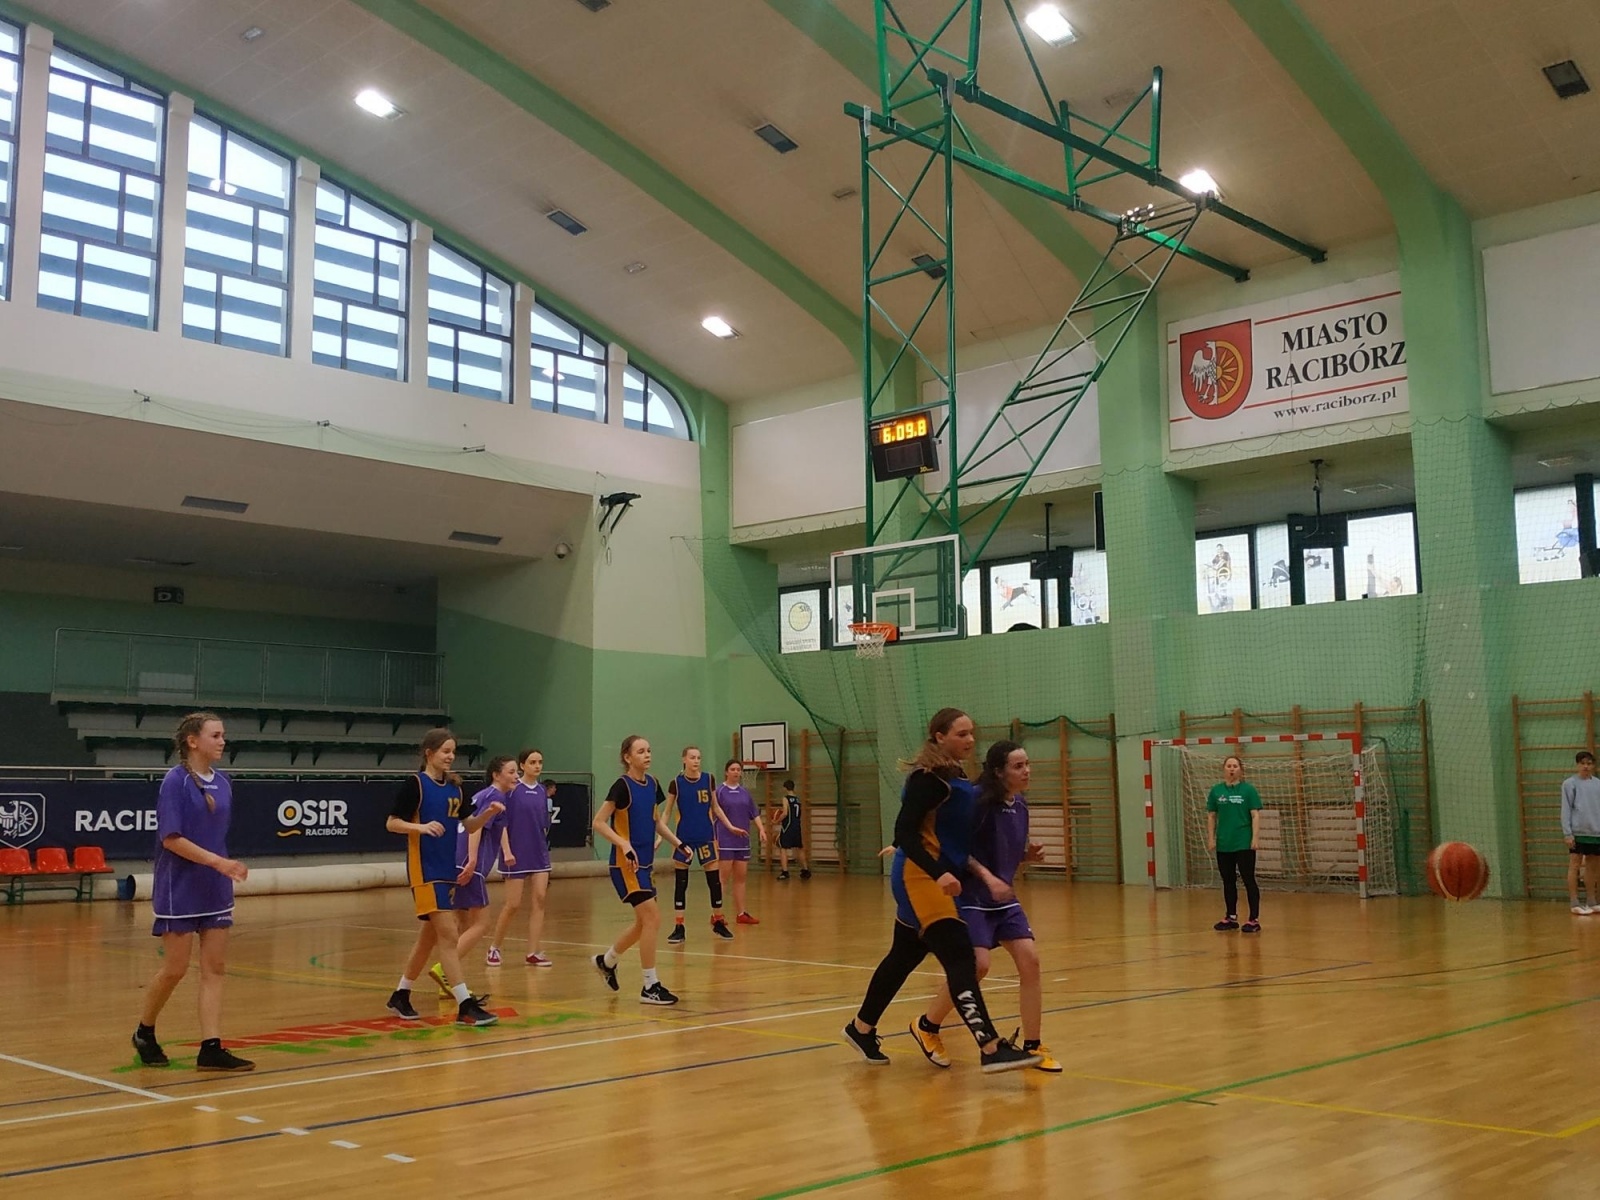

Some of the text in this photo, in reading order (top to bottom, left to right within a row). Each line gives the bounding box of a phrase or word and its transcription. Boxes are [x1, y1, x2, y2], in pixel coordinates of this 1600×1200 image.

[1282, 311, 1388, 354] MIASTO
[1265, 341, 1407, 390] RACIBÓRZ
[1273, 387, 1397, 419] www.raciborz.pl
[697, 789, 709, 803] 15
[447, 797, 461, 818] 12
[75, 809, 158, 832] RACIB
[305, 826, 349, 836] RACIBÓRZ
[698, 844, 711, 860] 15
